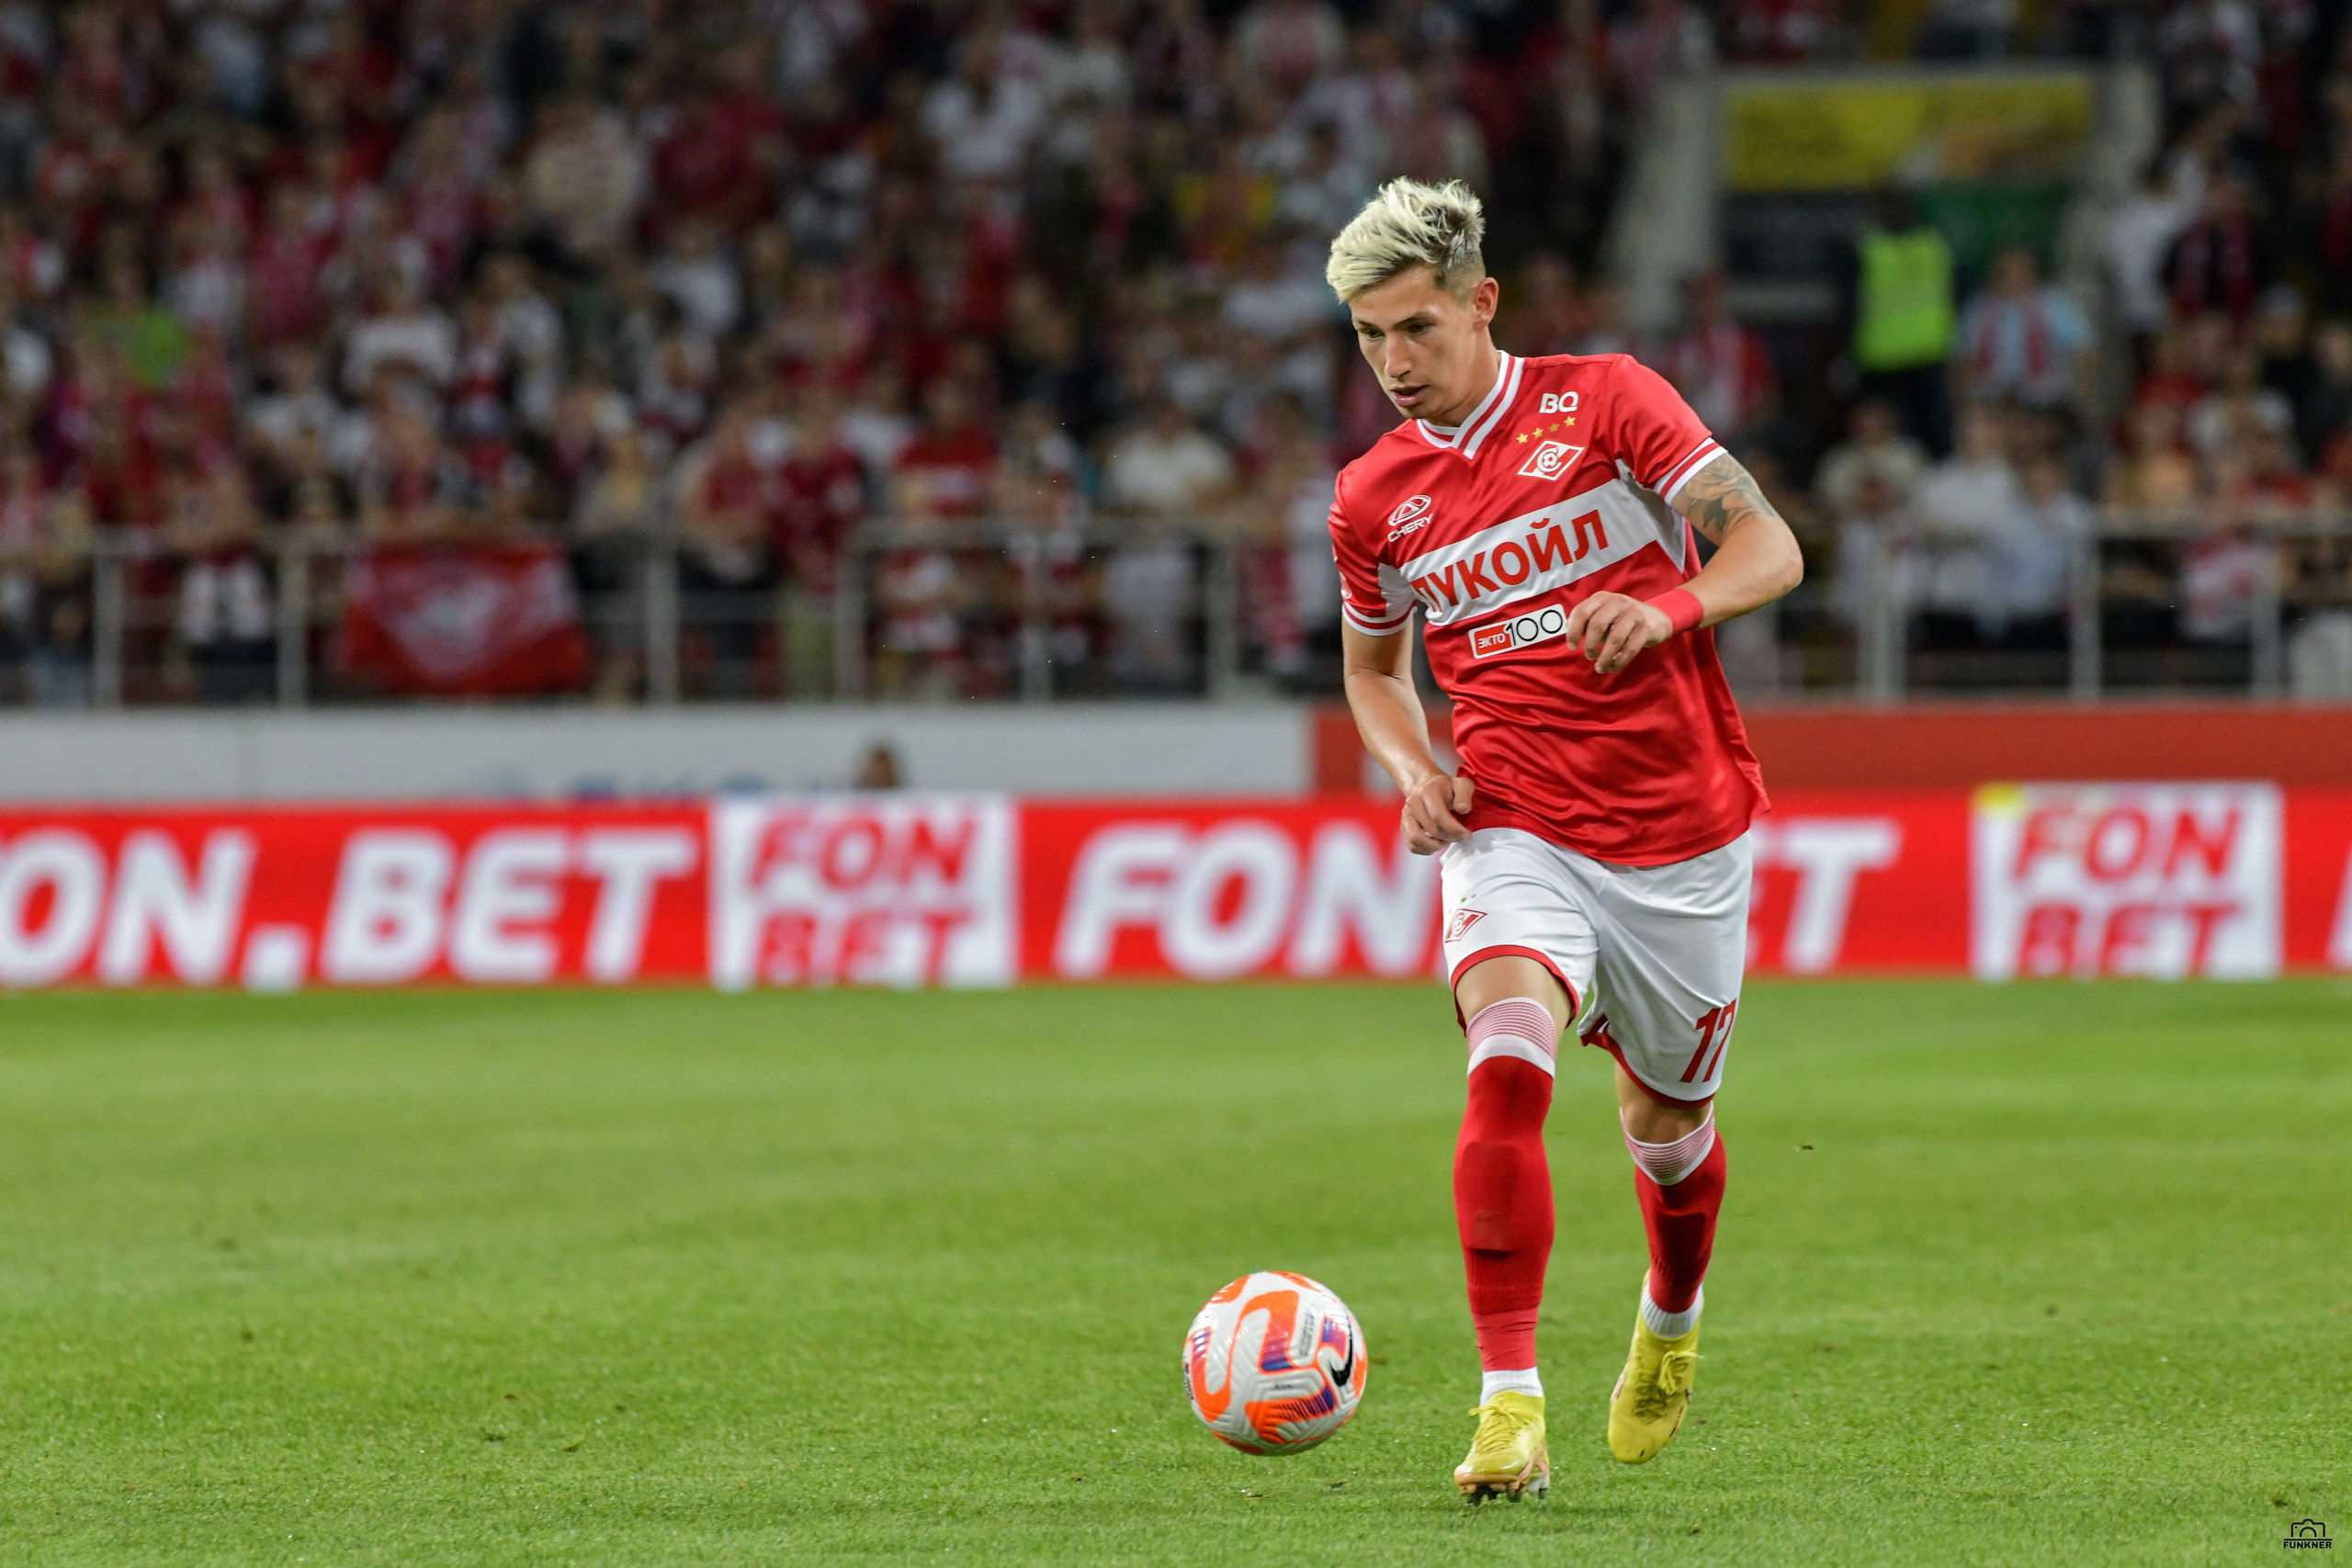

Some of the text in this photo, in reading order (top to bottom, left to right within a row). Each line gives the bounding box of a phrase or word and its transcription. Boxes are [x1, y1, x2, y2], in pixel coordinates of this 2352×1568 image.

[1539, 390, 1579, 414] BQ
[1387, 513, 1433, 543] CHERY
[1409, 509, 1610, 614] ЛУКОЙЛ
[1477, 609, 1564, 649] ЭКТО 100
[748, 810, 976, 890] FON
[2014, 805, 2242, 882] FON
[1679, 998, 1737, 1084] 17
